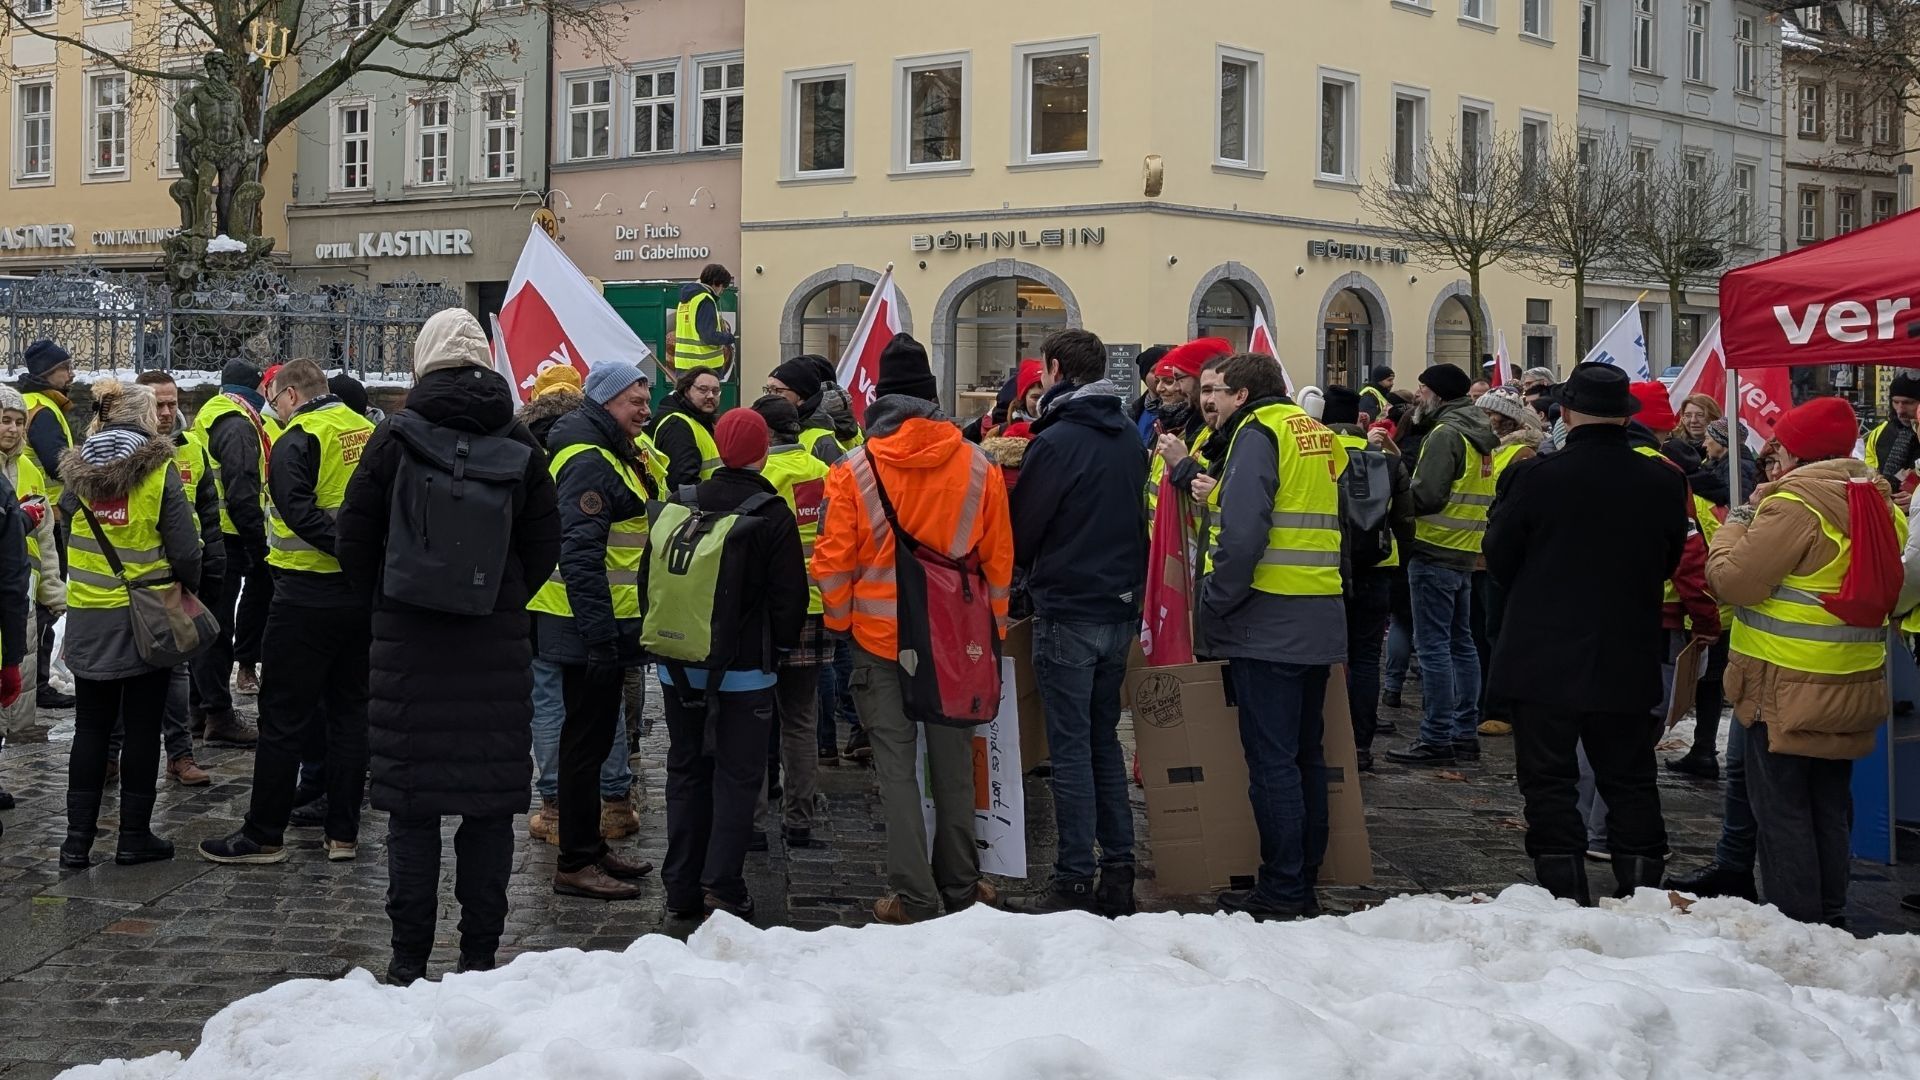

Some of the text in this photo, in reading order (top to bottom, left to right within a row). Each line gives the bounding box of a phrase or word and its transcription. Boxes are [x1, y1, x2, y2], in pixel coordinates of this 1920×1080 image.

[0, 223, 76, 250] ASTNER
[615, 222, 681, 240] Der Fuchs
[911, 226, 1105, 251] BÖHNLEIN
[315, 229, 474, 260] OPTIK KASTNER
[614, 243, 710, 260] am Gabelmoo
[93, 508, 126, 520] ver.di
[991, 756, 1001, 773] es
